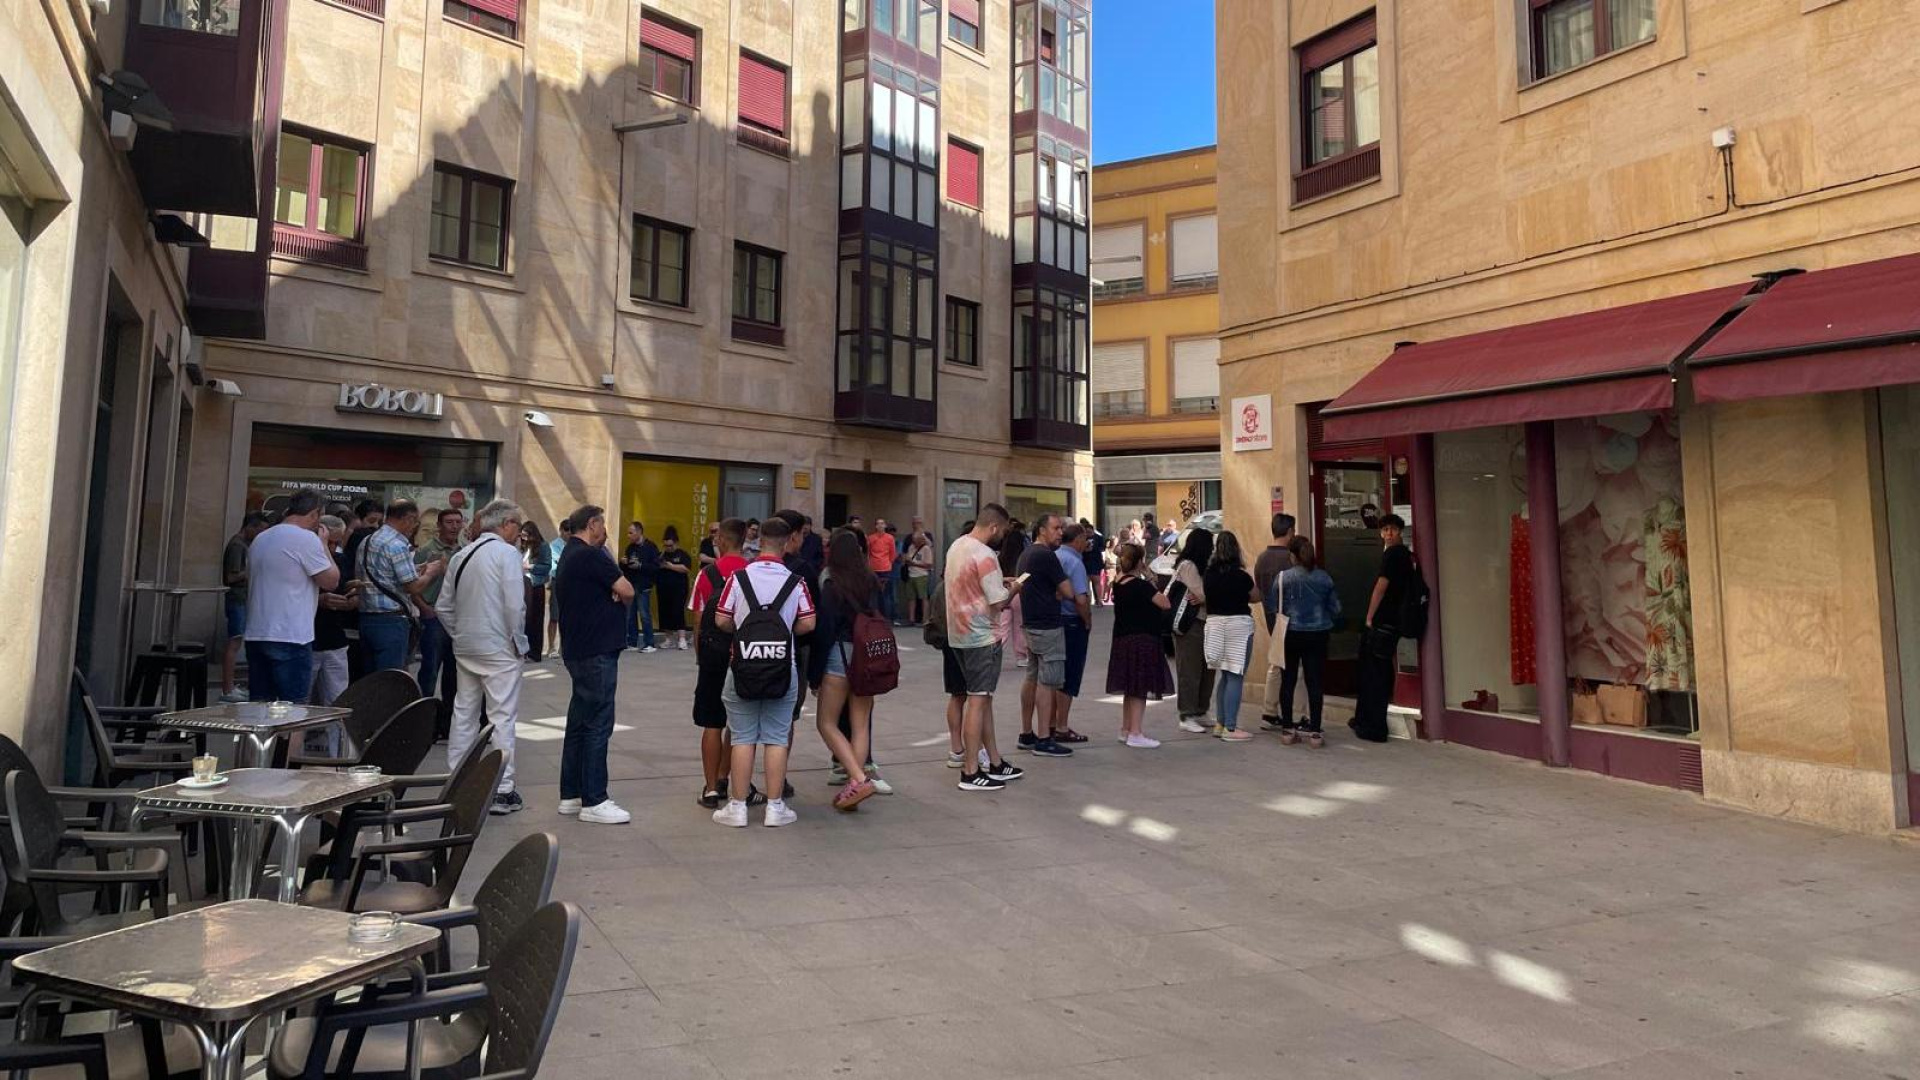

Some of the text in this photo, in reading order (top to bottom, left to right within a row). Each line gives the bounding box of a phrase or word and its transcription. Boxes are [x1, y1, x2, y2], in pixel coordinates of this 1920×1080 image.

[281, 481, 298, 489] FIFA
[299, 482, 326, 491] WORLD
[327, 484, 343, 492] CUP
[739, 640, 787, 660] VANS
